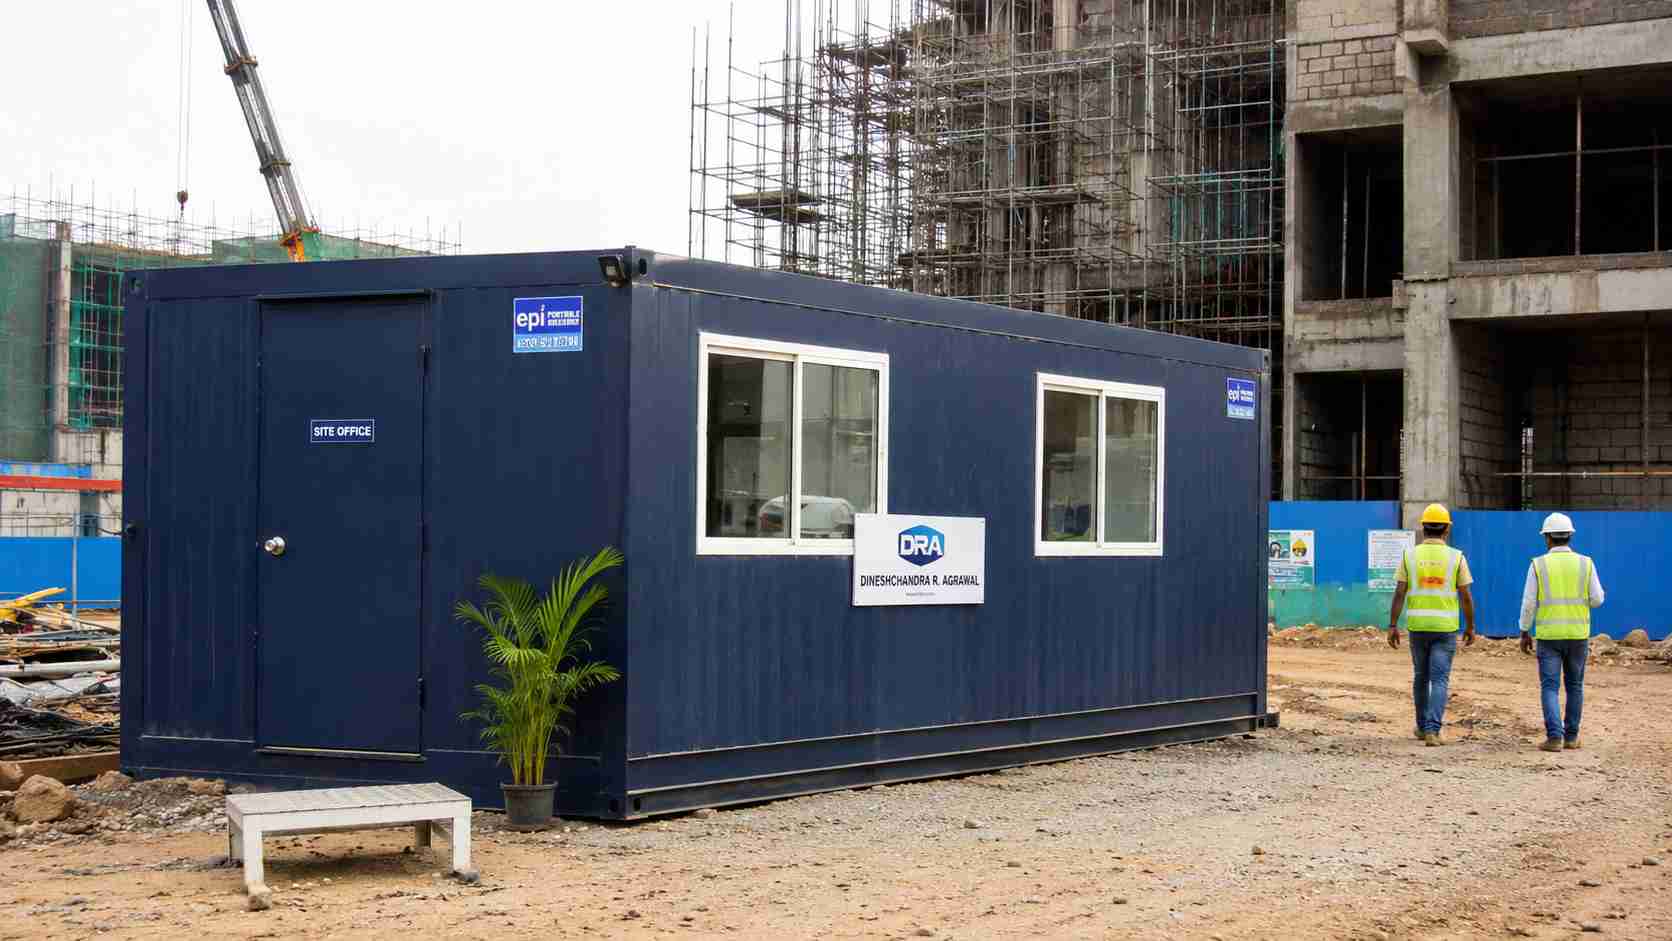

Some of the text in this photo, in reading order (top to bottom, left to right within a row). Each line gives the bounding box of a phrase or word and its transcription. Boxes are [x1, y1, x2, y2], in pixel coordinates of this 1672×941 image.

[516, 304, 545, 332] epi
[313, 426, 372, 437] SITE OFFICE
[900, 535, 943, 556] DRA
[860, 575, 980, 587] DINESHCHANDRA R. AGRAWAL
